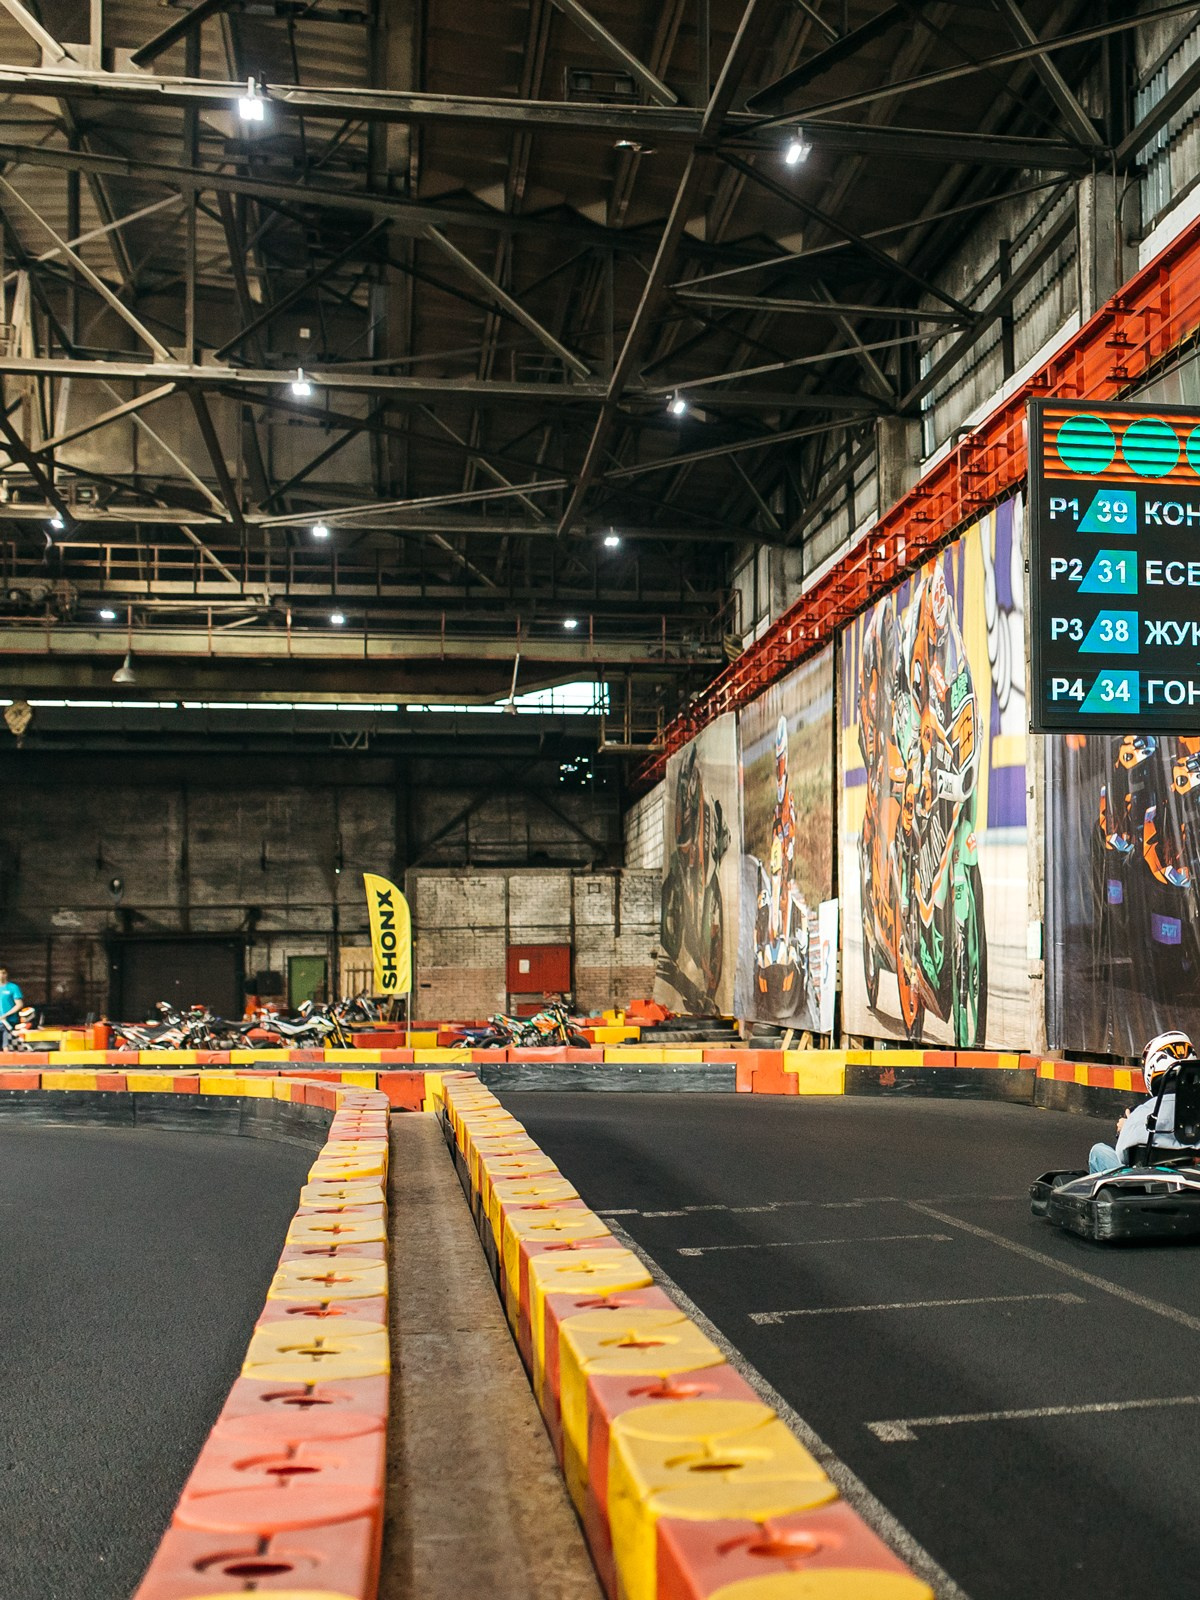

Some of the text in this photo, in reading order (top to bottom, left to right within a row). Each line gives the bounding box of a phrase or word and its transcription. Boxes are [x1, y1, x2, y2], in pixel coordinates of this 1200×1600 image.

[1049, 497, 1079, 520] P1
[1097, 500, 1128, 523] 39
[1050, 557, 1083, 581] P2
[1098, 560, 1126, 583] 31
[1051, 617, 1084, 641] P3
[1099, 619, 1129, 642] 38
[1051, 678, 1086, 701] P4
[1100, 679, 1131, 702] 34
[376, 889, 398, 990] SHONX
